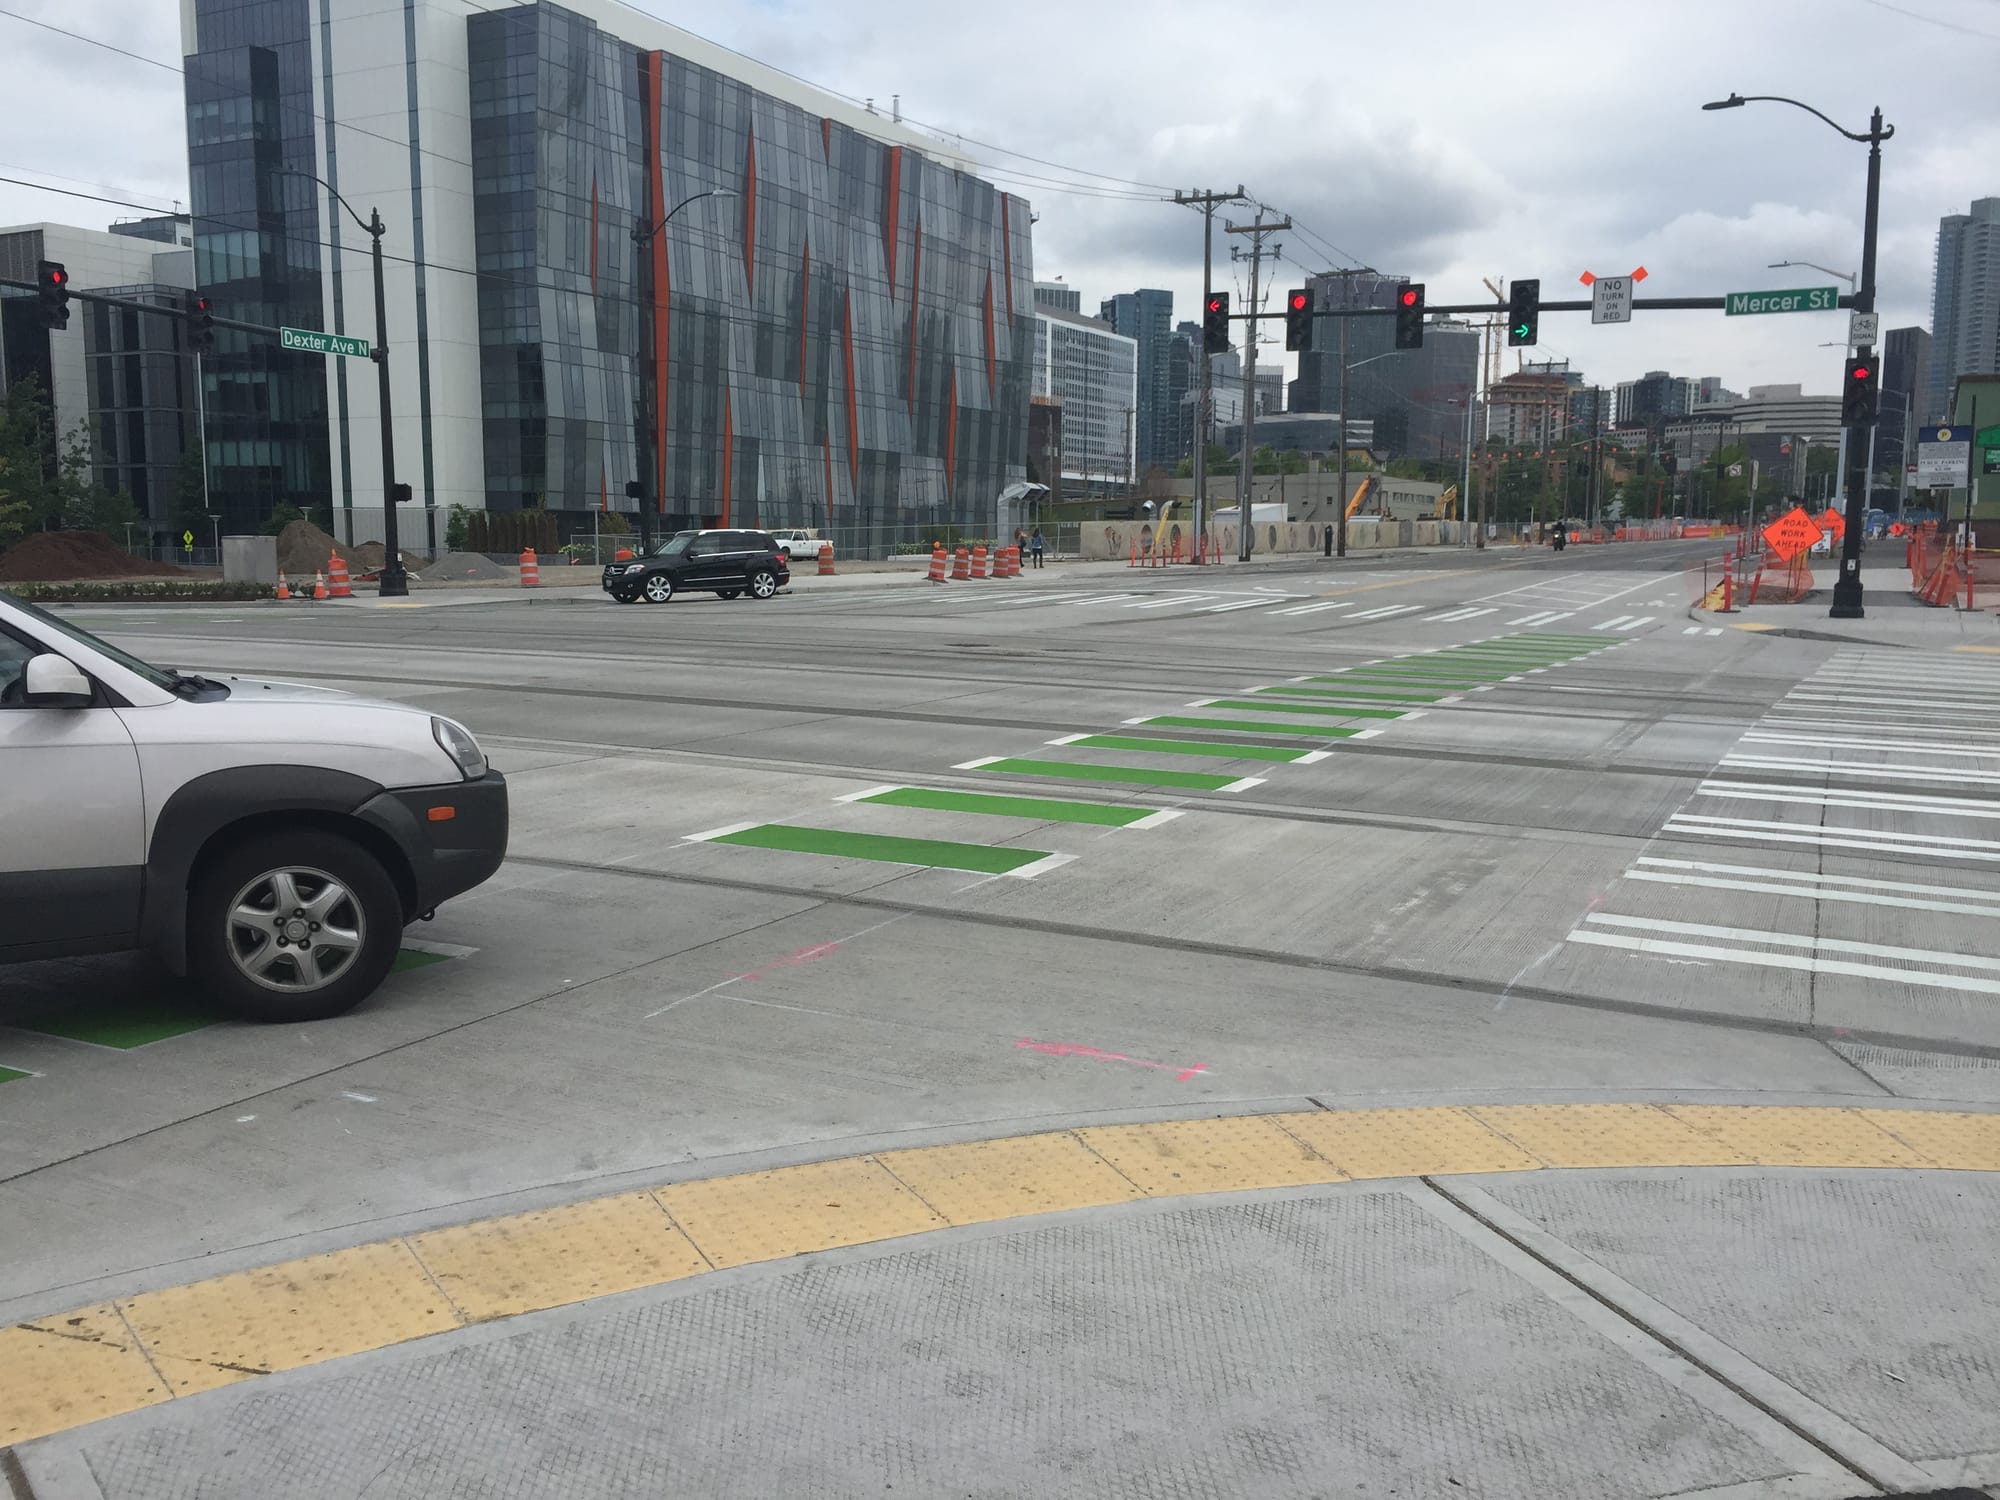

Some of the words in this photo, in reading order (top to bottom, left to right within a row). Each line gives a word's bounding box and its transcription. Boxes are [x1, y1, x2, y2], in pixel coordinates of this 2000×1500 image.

[1604, 281, 1621, 291] NO
[1601, 292, 1624, 301] TURN
[1606, 302, 1618, 310] ON
[1733, 295, 1802, 313] Mercer
[1809, 290, 1830, 309] St
[1603, 312, 1620, 320] RED
[284, 331, 326, 350] Dexter
[331, 338, 354, 354] Ave
[359, 342, 367, 356] N
[1783, 519, 1808, 528] ROAD
[1781, 530, 1805, 538] WORK
[1776, 540, 1806, 548] AHEAD
